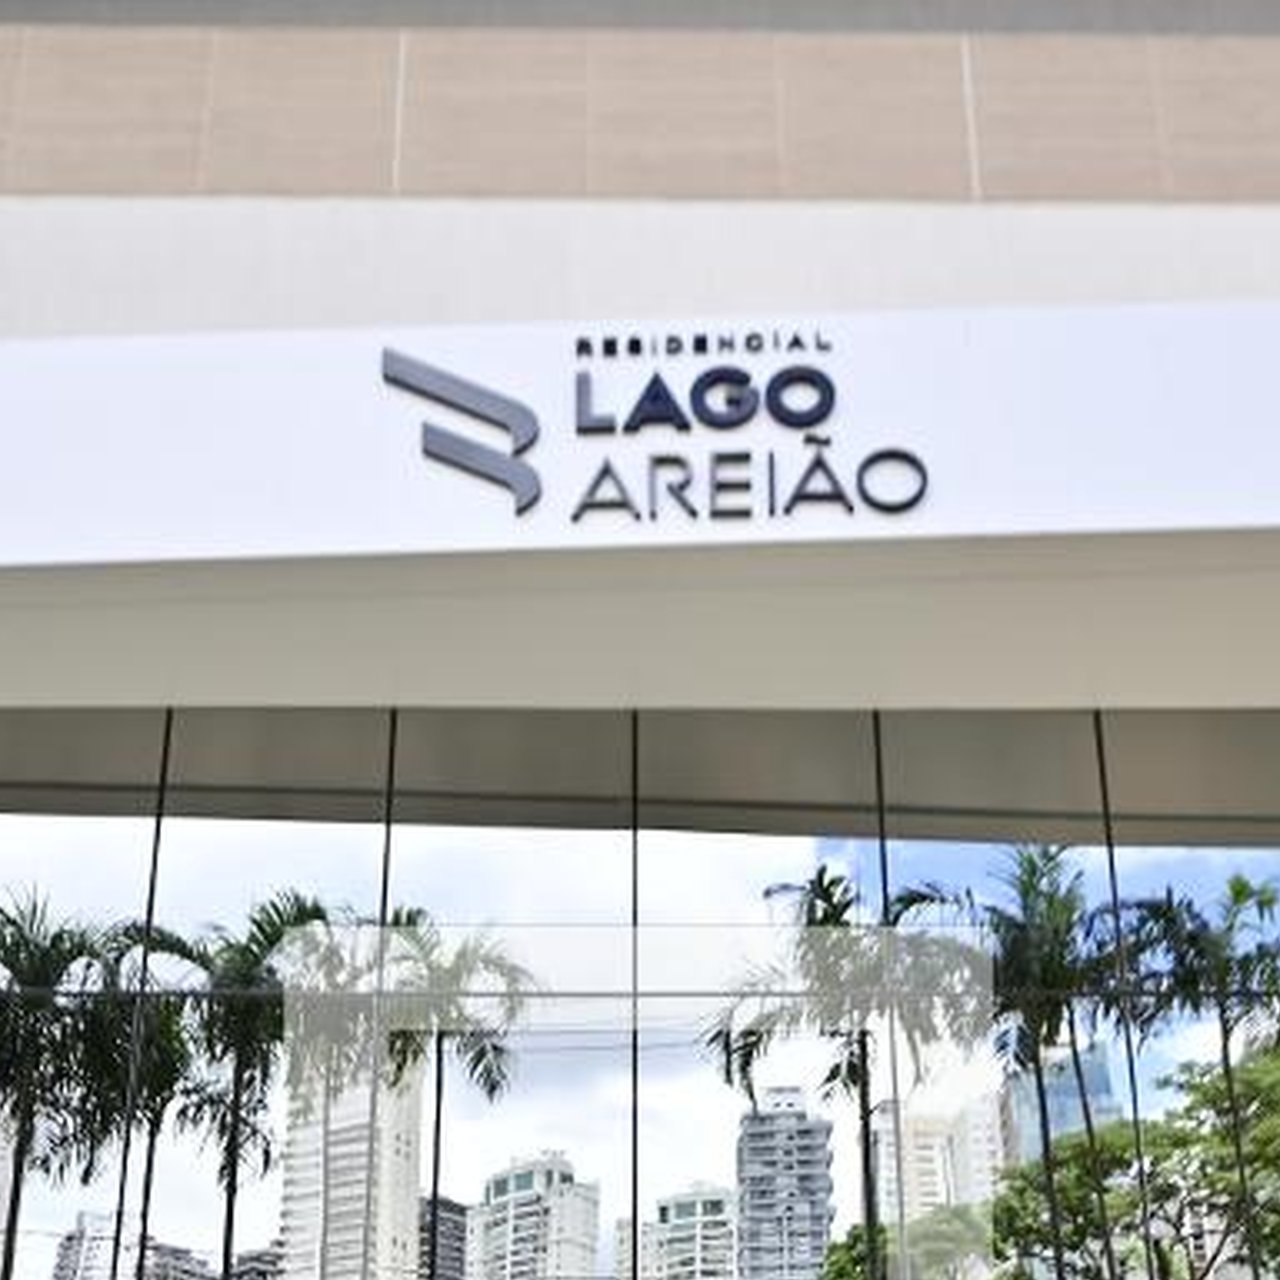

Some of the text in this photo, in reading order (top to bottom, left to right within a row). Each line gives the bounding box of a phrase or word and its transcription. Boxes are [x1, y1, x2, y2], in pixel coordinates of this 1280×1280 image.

[576, 330, 833, 357] RESIDENCIAL
[575, 365, 836, 435] LAGO
[571, 433, 929, 523] AREIÃO
